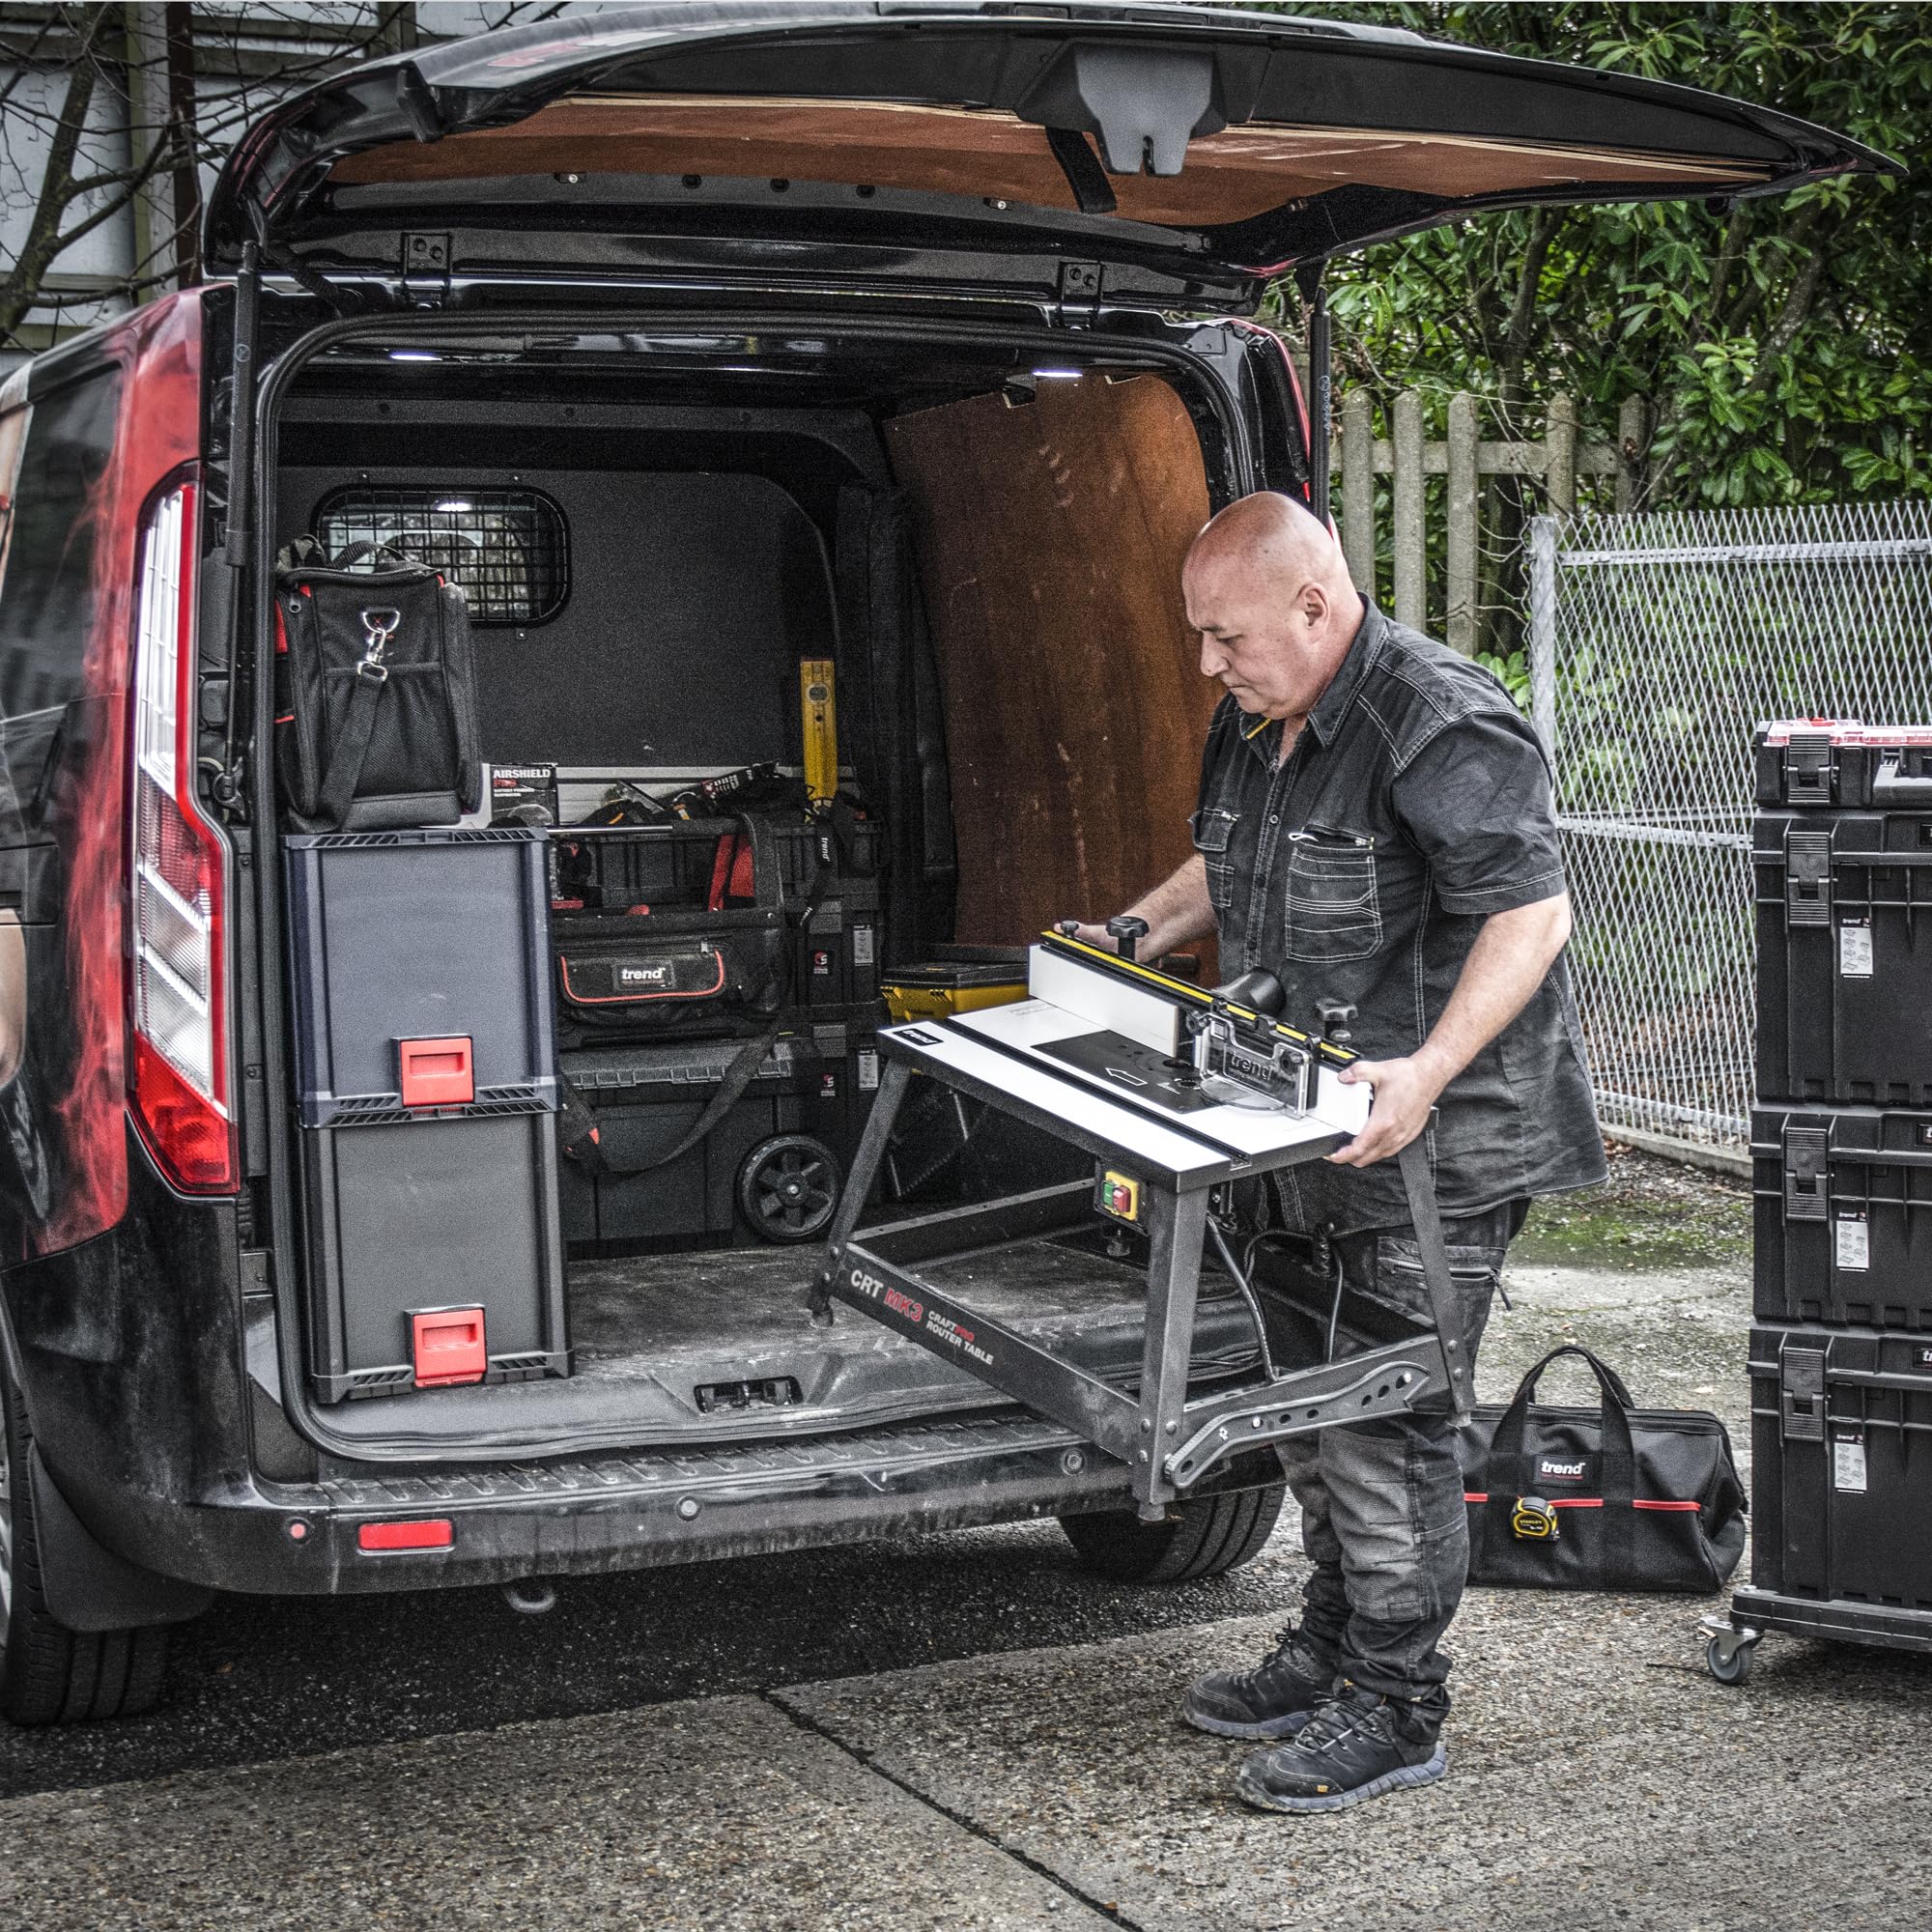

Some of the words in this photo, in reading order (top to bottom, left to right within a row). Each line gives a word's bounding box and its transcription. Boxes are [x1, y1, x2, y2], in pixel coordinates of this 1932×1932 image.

[493, 769, 551, 779] AIRSHIELD
[821, 838, 830, 861] trend
[621, 967, 666, 980] trend
[1230, 1050, 1276, 1081] trend
[851, 1269, 884, 1298] CRT
[884, 1288, 923, 1322] MK3
[926, 1321, 962, 1347] ROUTER
[961, 1341, 994, 1366] TABLE
[1542, 1461, 1586, 1474] trend
